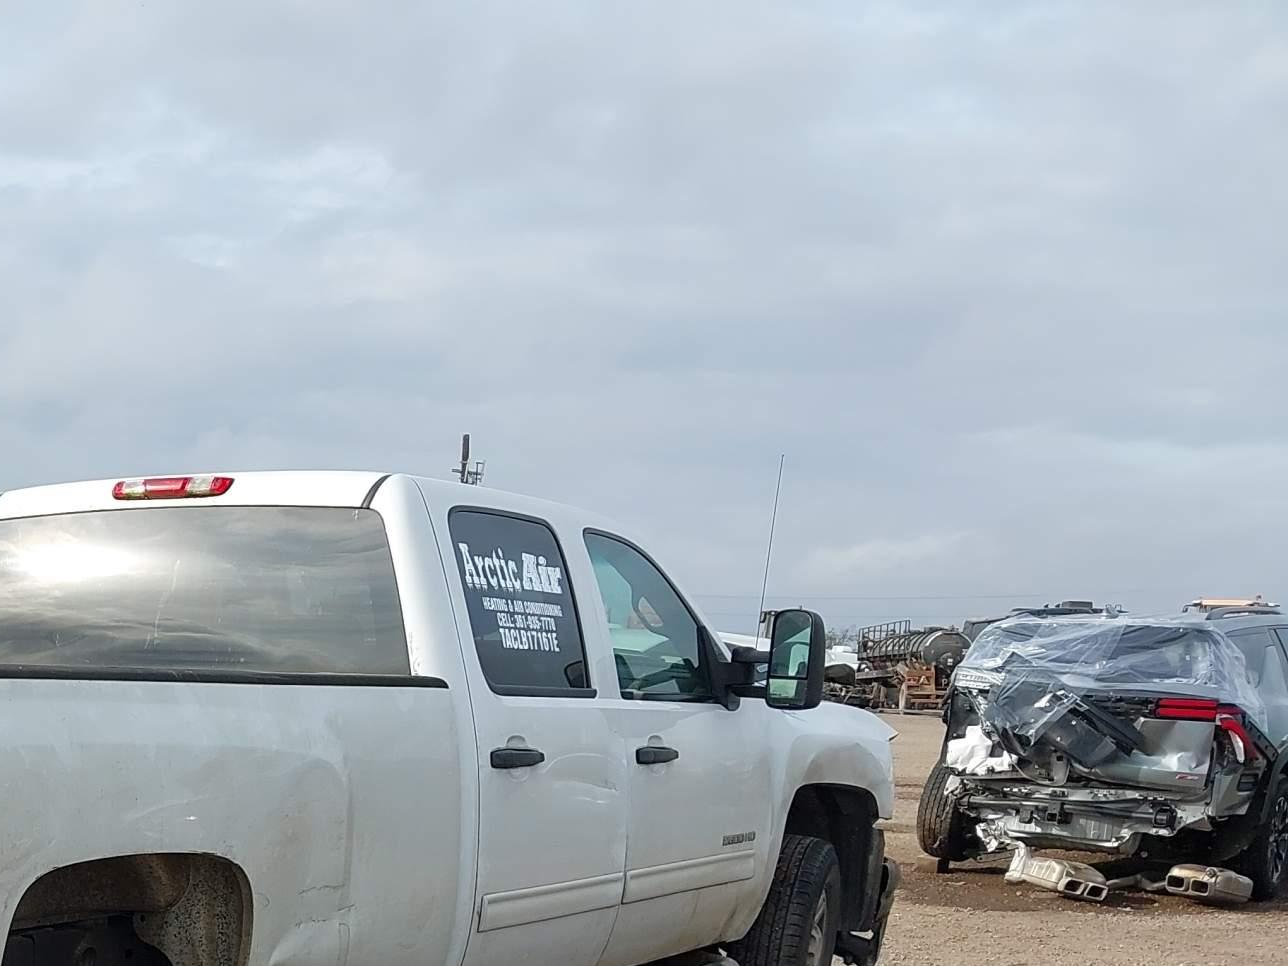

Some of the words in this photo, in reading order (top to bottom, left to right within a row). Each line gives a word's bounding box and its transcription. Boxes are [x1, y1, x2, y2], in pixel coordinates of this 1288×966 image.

[458, 543, 521, 592] Arctic
[522, 552, 562, 594] Air
[482, 597, 508, 611] HEATING
[514, 600, 524, 613] AIR
[524, 601, 563, 617] CONDITIONING
[497, 612, 515, 628] CELL:
[499, 628, 560, 652] TACLB17161E
